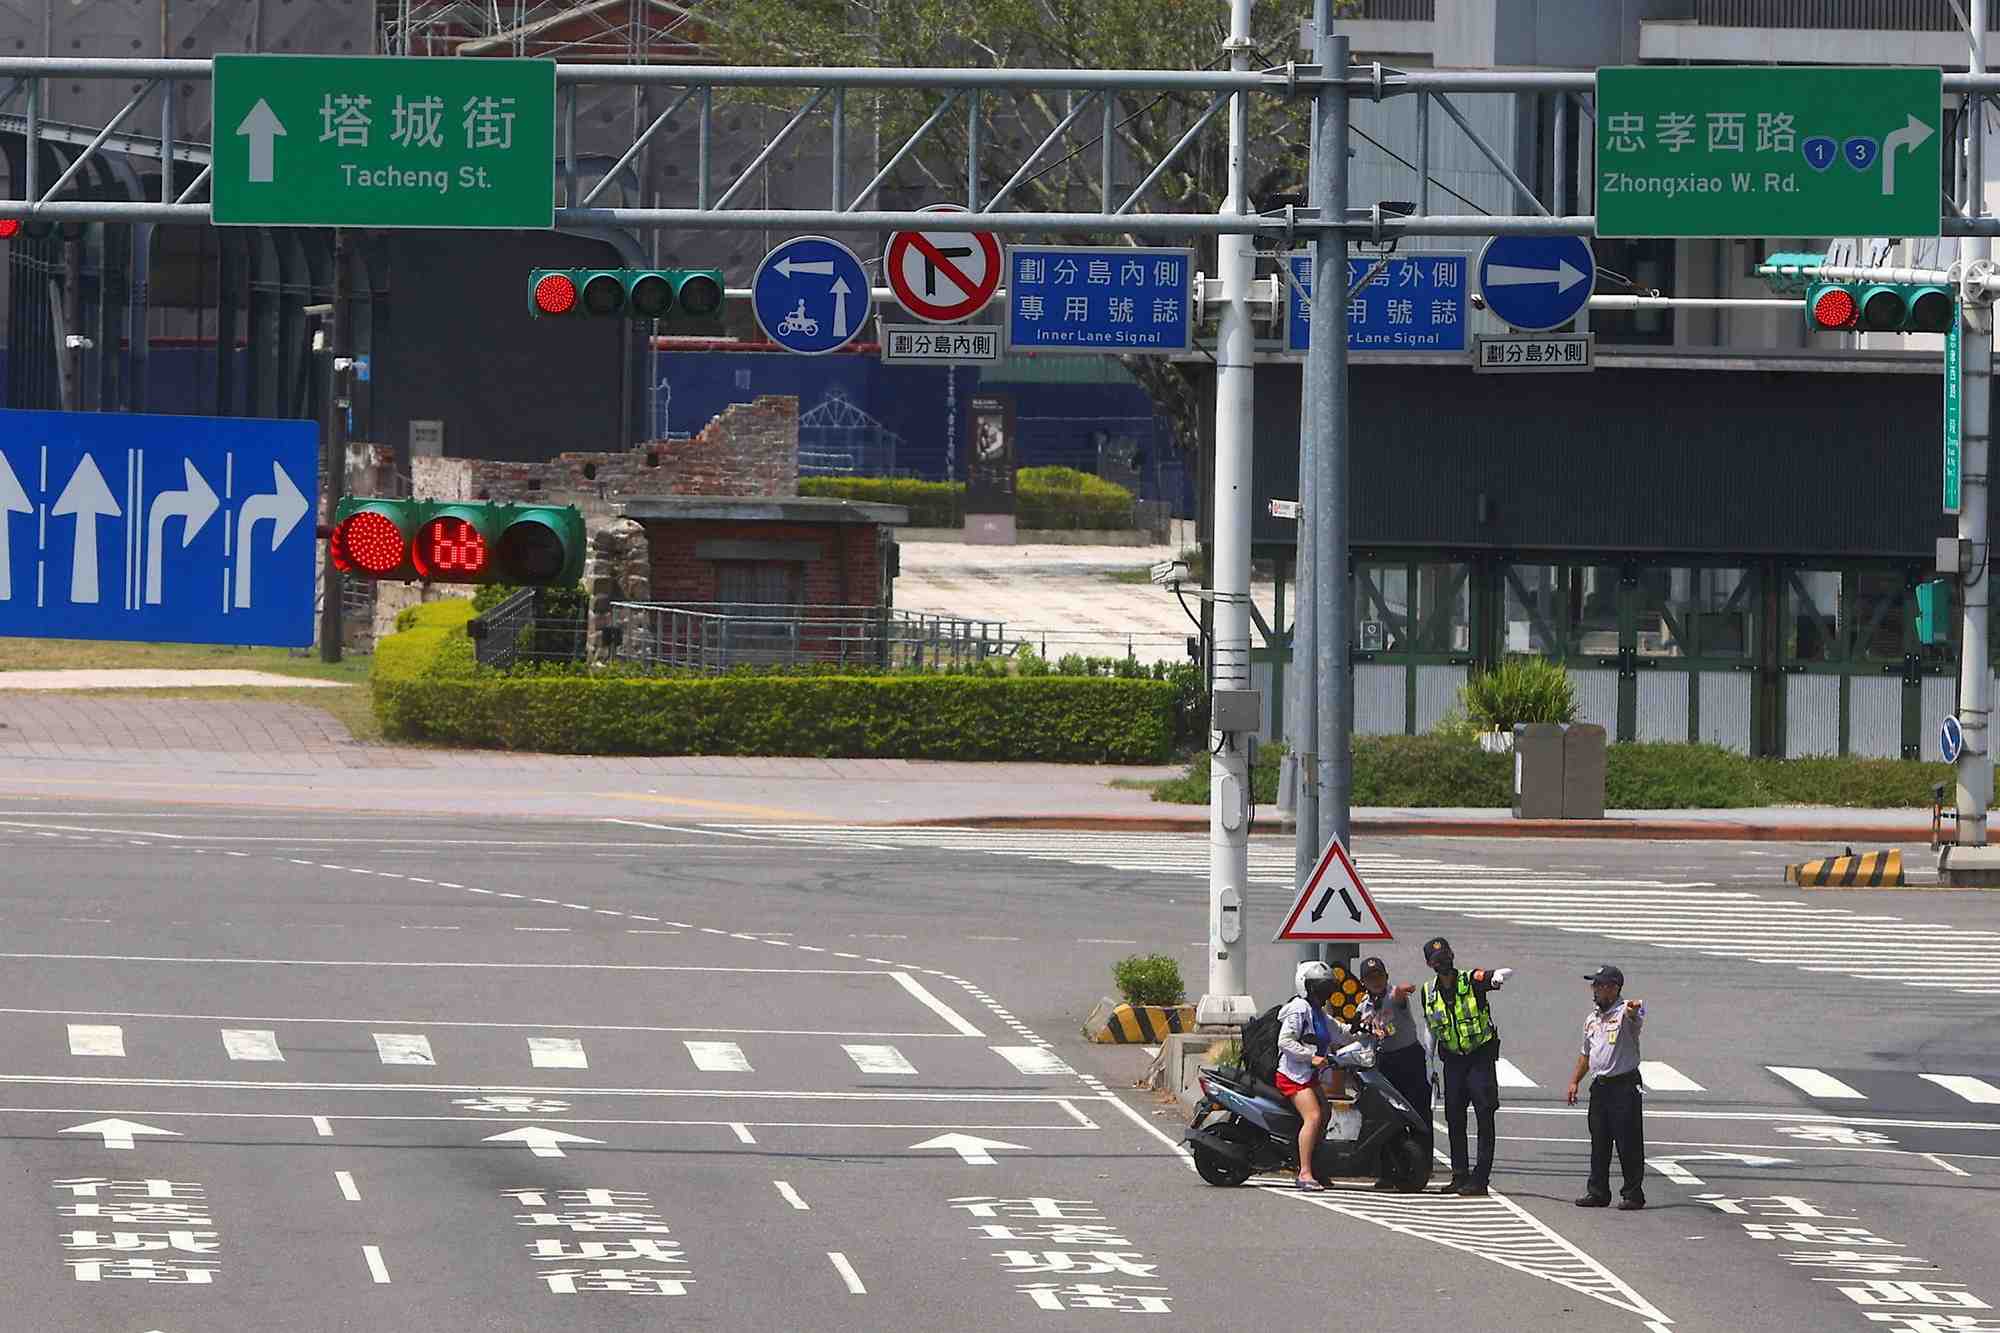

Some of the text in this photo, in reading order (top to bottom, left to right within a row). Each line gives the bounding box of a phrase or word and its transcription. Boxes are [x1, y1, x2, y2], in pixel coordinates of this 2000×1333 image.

[319, 94, 516, 150] 塔城街
[1606, 111, 1797, 154] 忠孝西路
[1815, 144, 1866, 161] 1 3
[340, 164, 492, 194] Tacheng St.
[1603, 172, 1800, 199] Zhongxiao W. Rd.
[1018, 257, 1179, 288] 劃分島內側
[1018, 294, 1179, 324] 專用號誌
[894, 335, 990, 356] 劃分島內側
[1036, 328, 1161, 345] Inner Lane Signal
[1356, 332, 1391, 344] Lane
[1394, 332, 1440, 347] Signal
[1486, 344, 1583, 364] 劃分島外側
